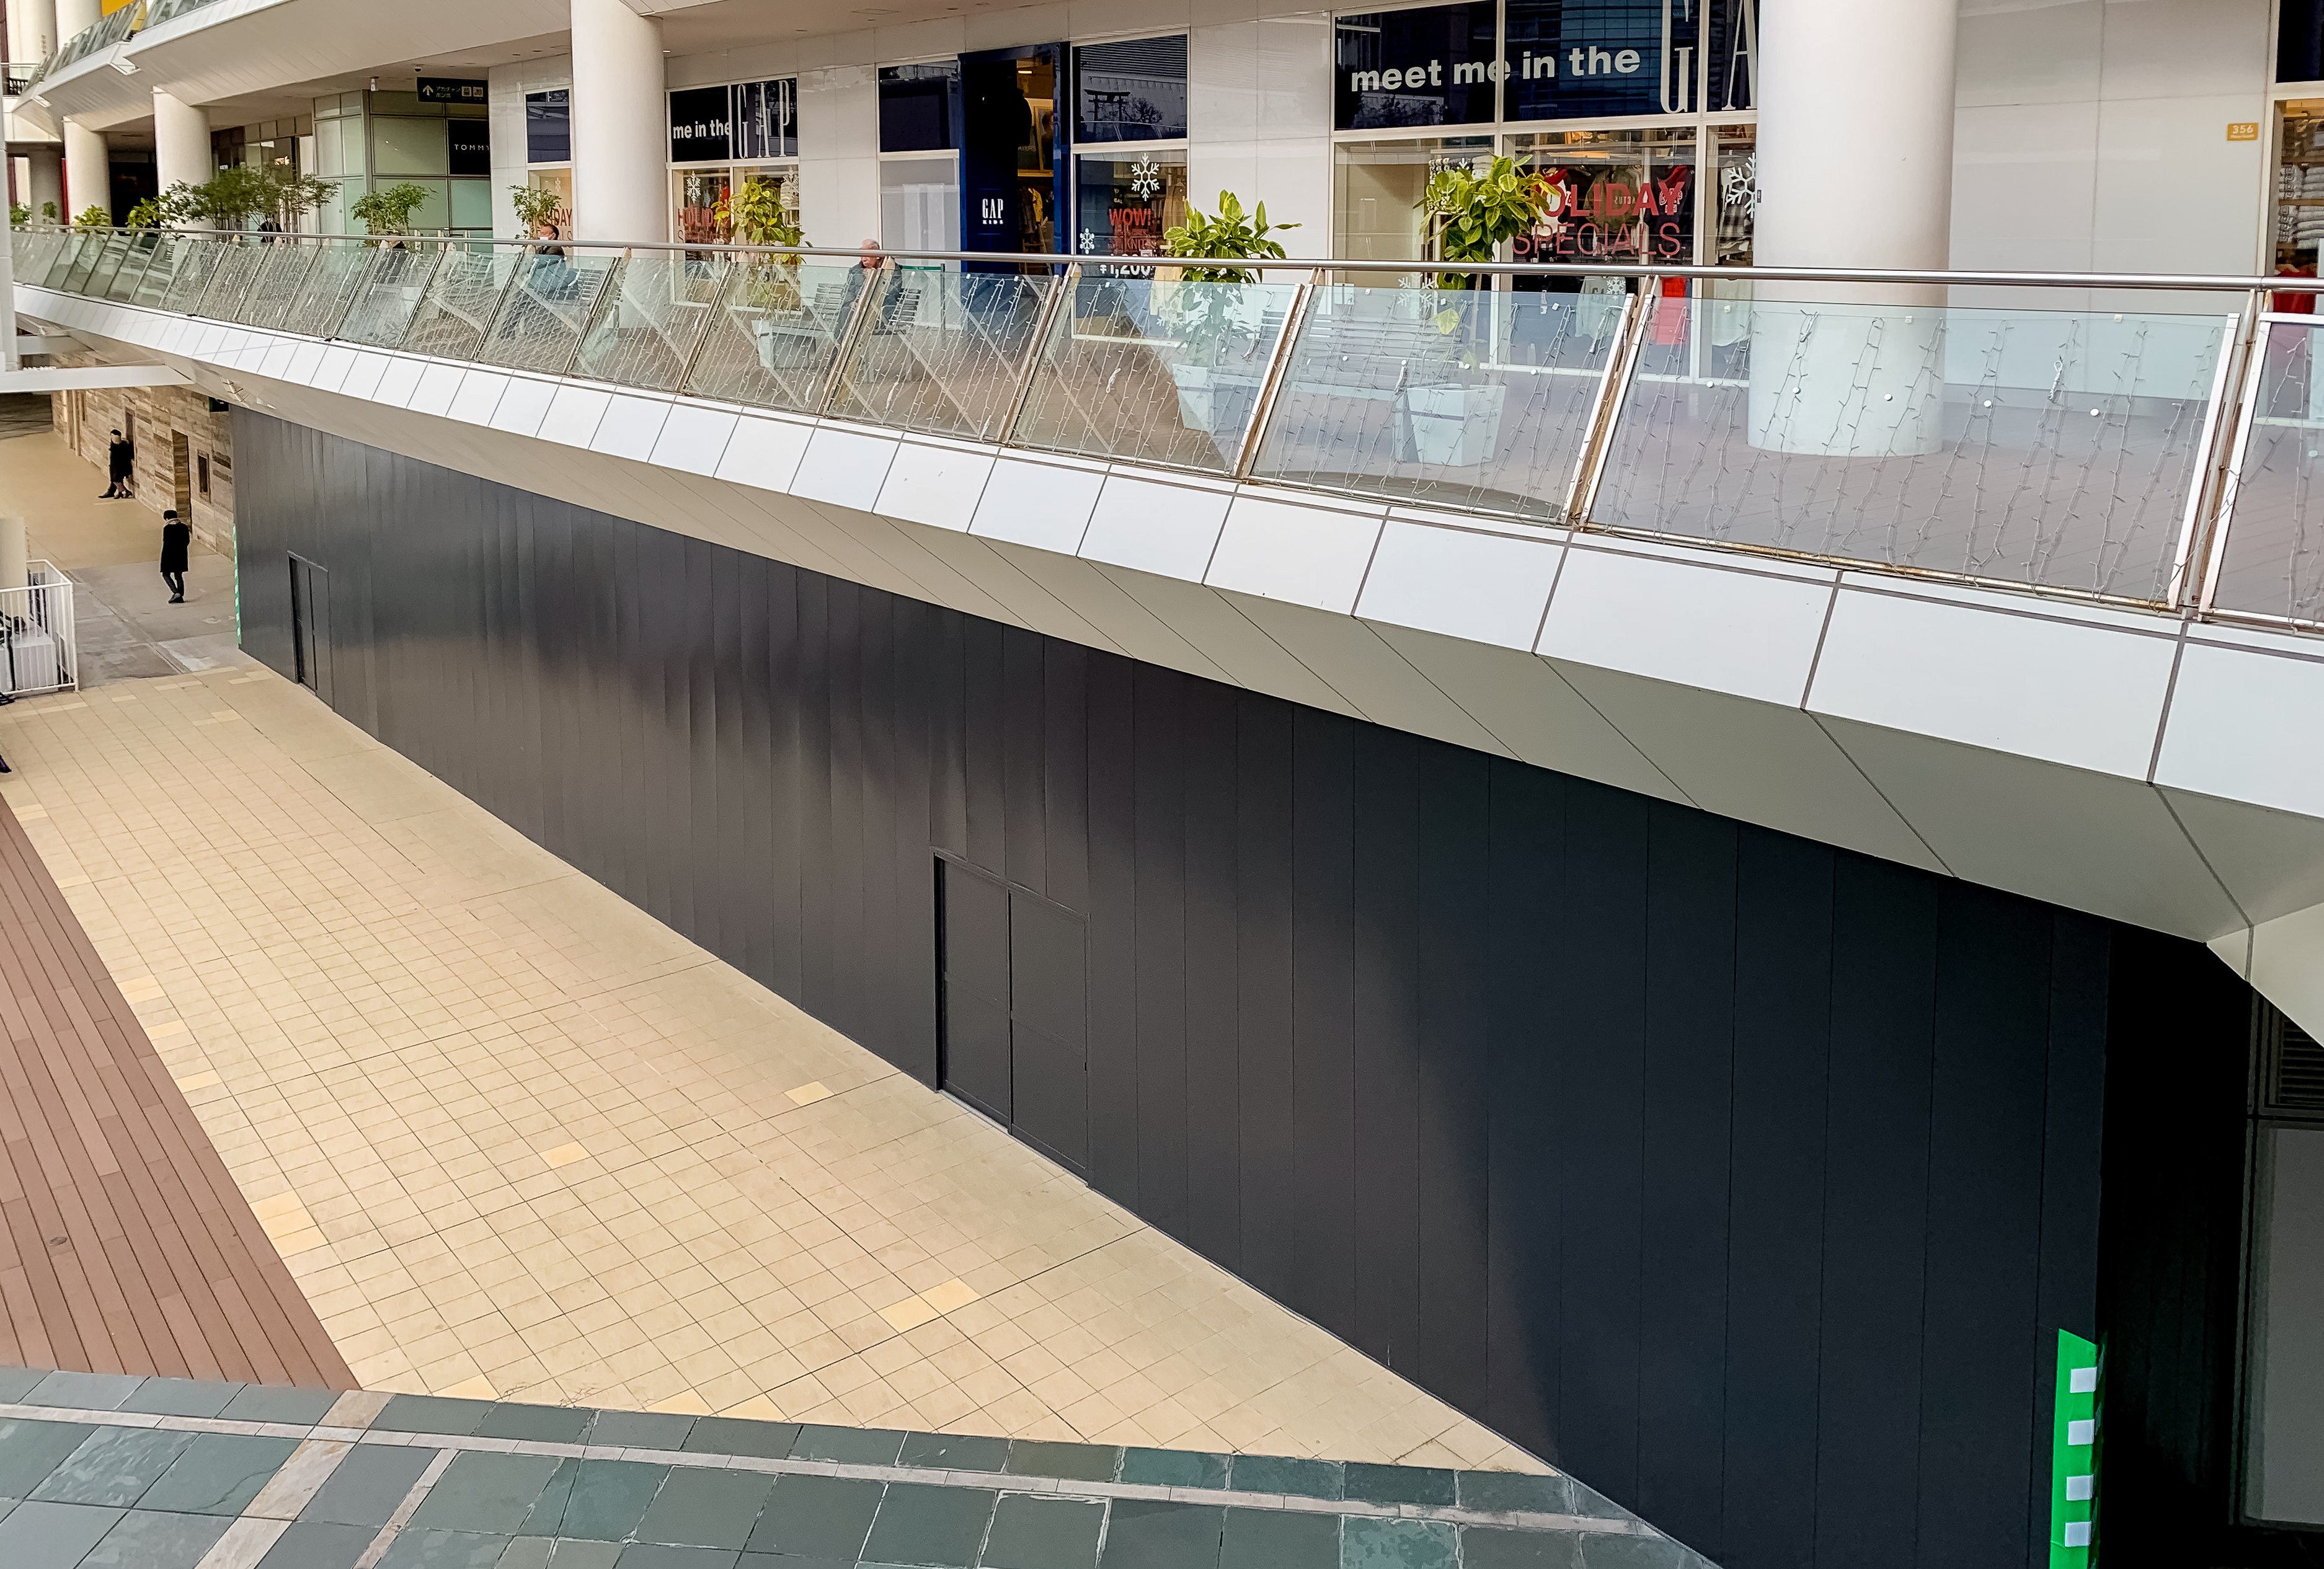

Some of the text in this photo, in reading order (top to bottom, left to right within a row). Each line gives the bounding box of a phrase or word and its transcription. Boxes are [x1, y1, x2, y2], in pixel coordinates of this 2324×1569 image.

[1352, 0, 1757, 113] meet me in the GA
[673, 81, 790, 159] me in the GAP
[2232, 125, 2253, 134] 356
[982, 198, 1004, 218] GAP
[1535, 182, 1685, 217] OLIDAY
[678, 207, 717, 227] HOLID
[1109, 208, 1151, 226] WOW!
[1512, 223, 1681, 255] SPECIALS
